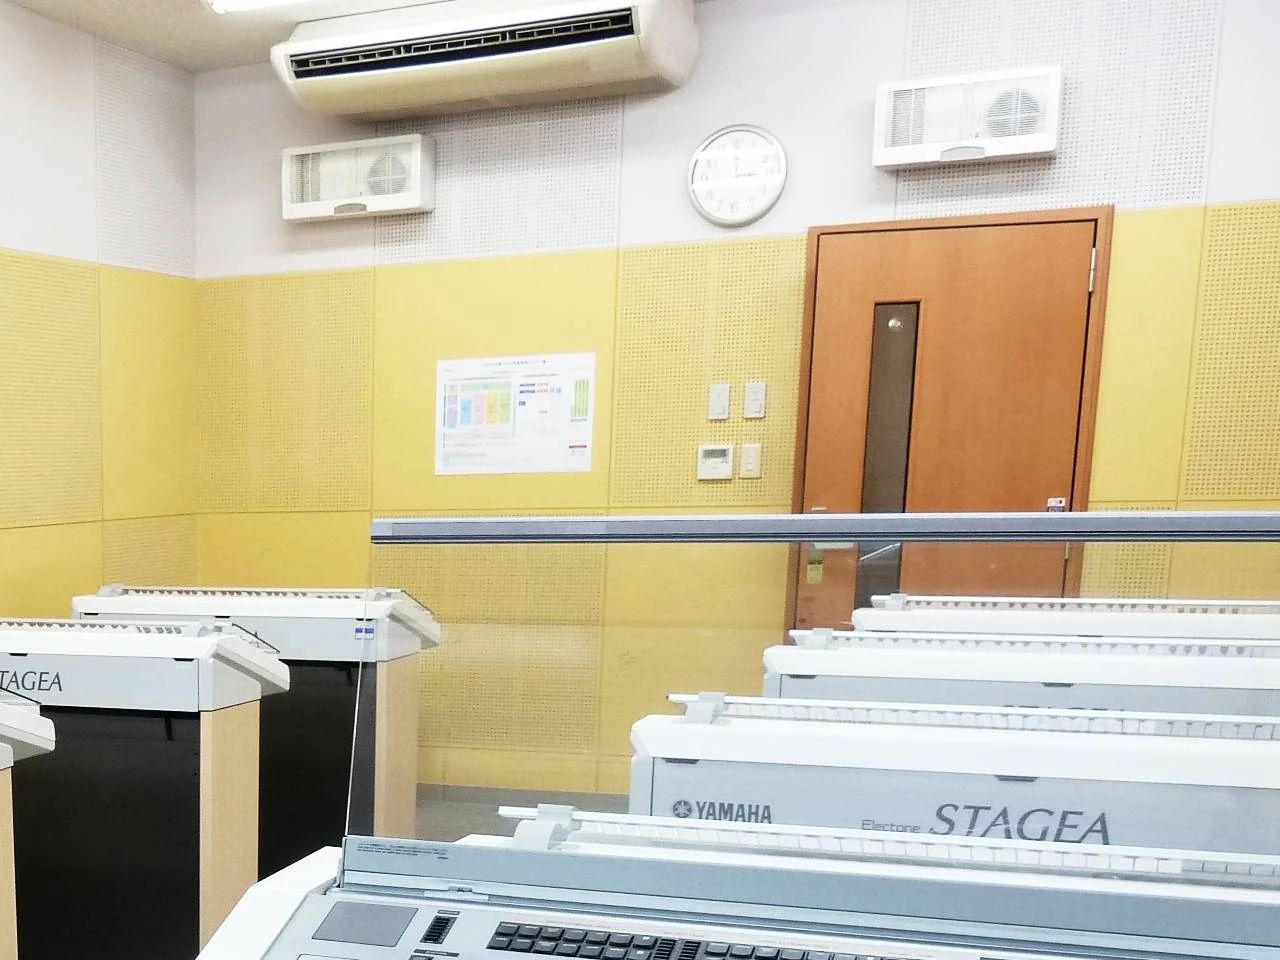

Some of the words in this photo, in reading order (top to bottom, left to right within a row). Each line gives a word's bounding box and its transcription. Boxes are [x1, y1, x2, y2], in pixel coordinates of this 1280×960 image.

[696, 800, 772, 824] YAMAHA
[861, 819, 920, 834] Electone
[928, 803, 1110, 846] STAGEA
